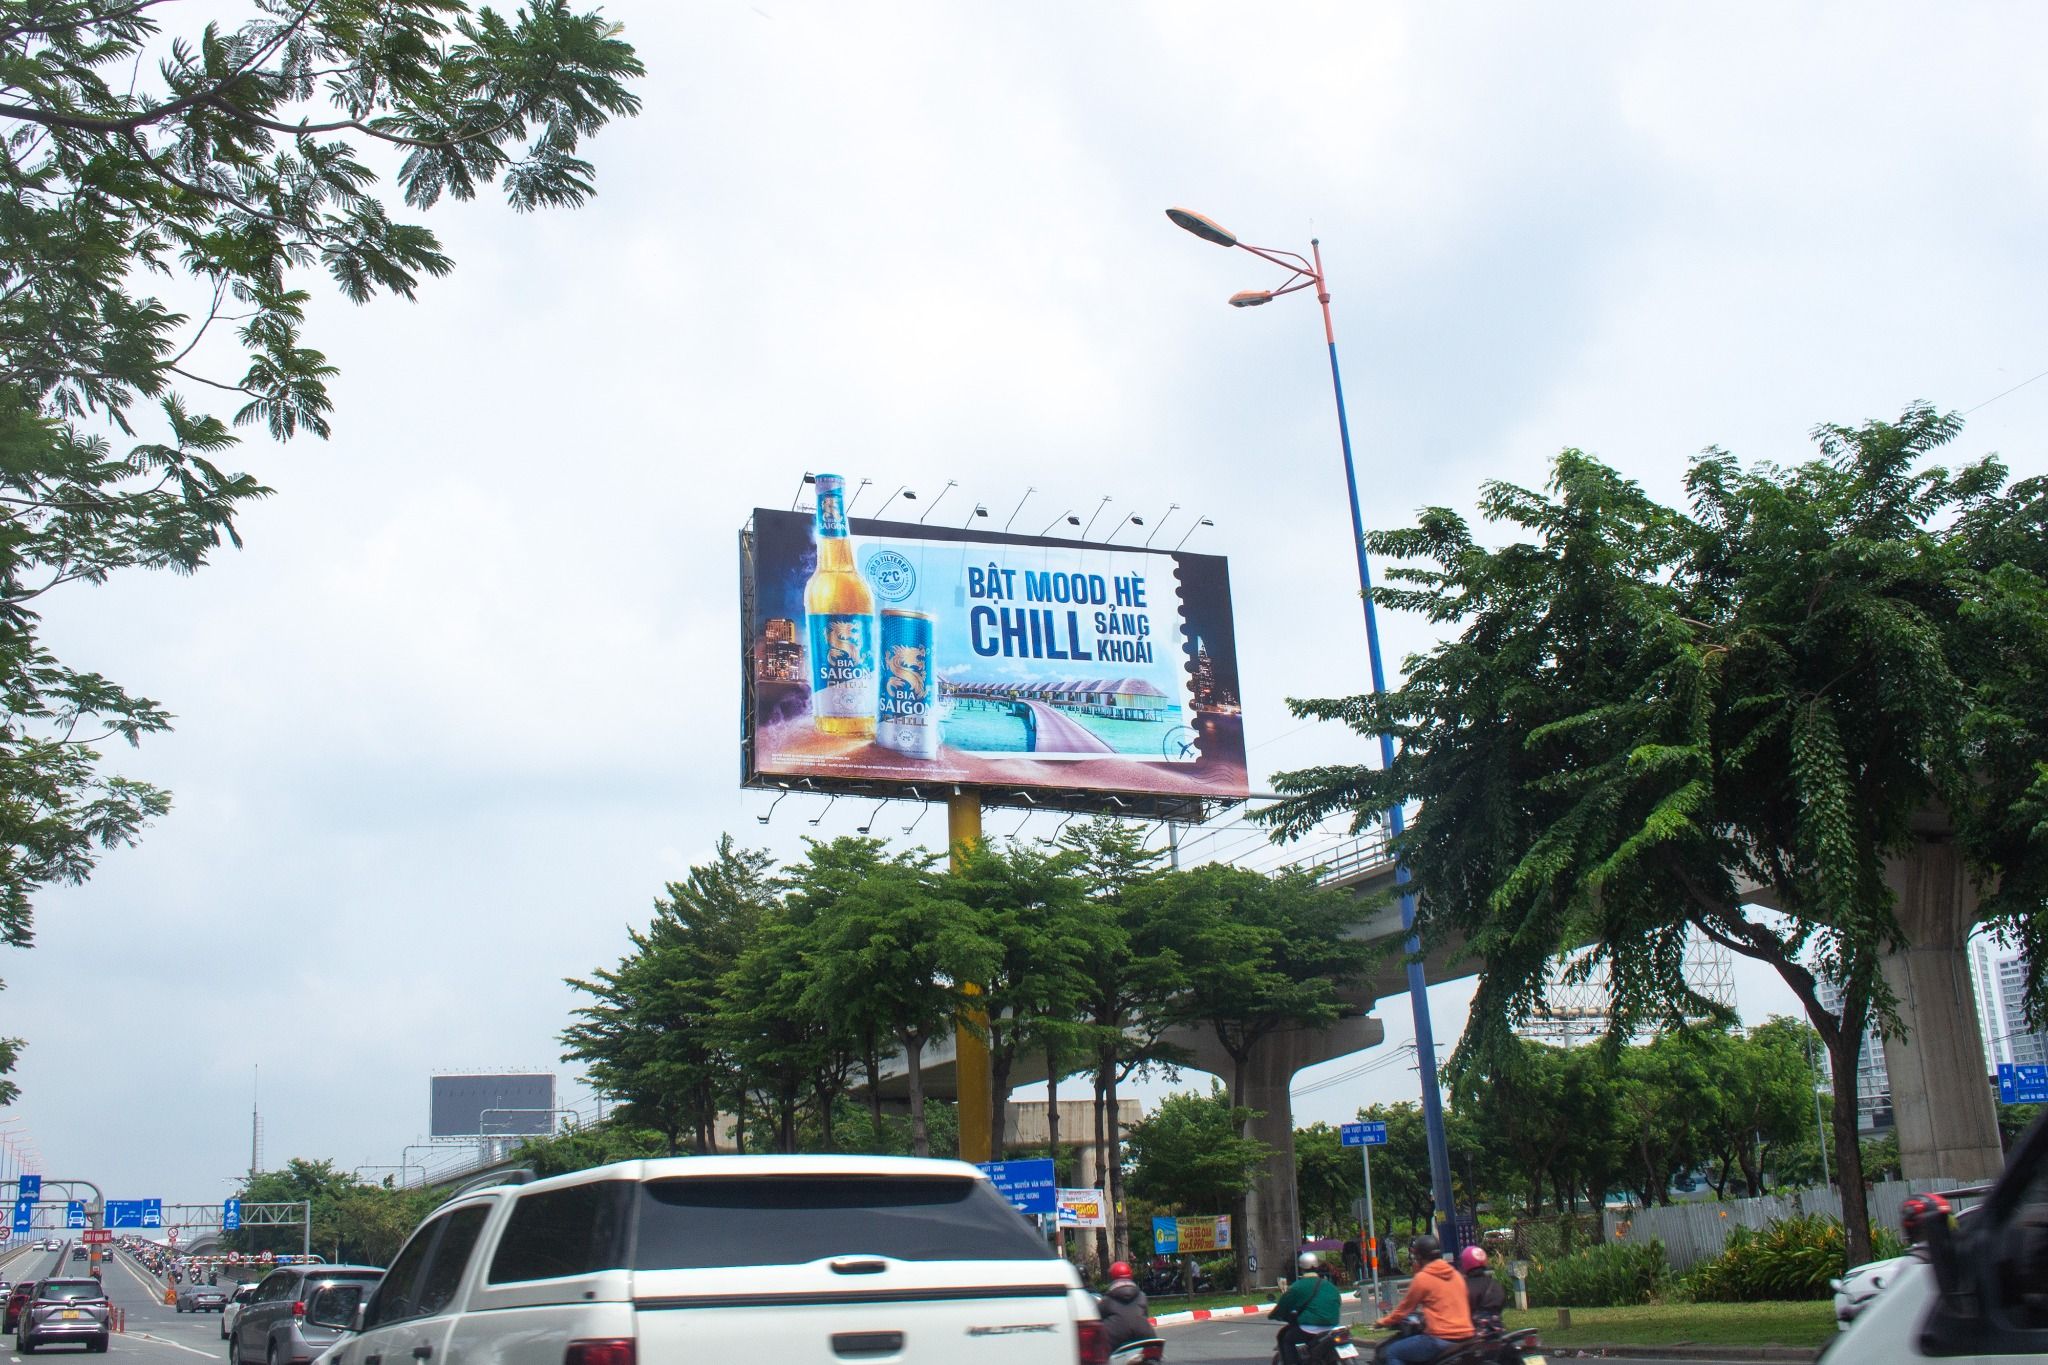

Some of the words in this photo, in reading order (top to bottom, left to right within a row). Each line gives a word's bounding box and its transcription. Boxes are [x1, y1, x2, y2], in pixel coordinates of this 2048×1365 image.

[870, 559, 881, 576] COLD
[880, 556, 909, 572] FILTERED
[968, 562, 1016, 604] BẬT
[1025, 570, 1106, 605] MOOD
[1114, 570, 1148, 608] HÈ
[1094, 603, 1150, 636] SẢNG
[970, 605, 1092, 661] CHILL
[1096, 634, 1154, 664] KHOÁI
[837, 660, 854, 668] BIA
[820, 667, 872, 680] SAIGON
[896, 690, 916, 700] BIA
[1014, 1180, 1030, 1189] NGUYỄN
[1015, 1191, 1026, 1200] QUỐC
